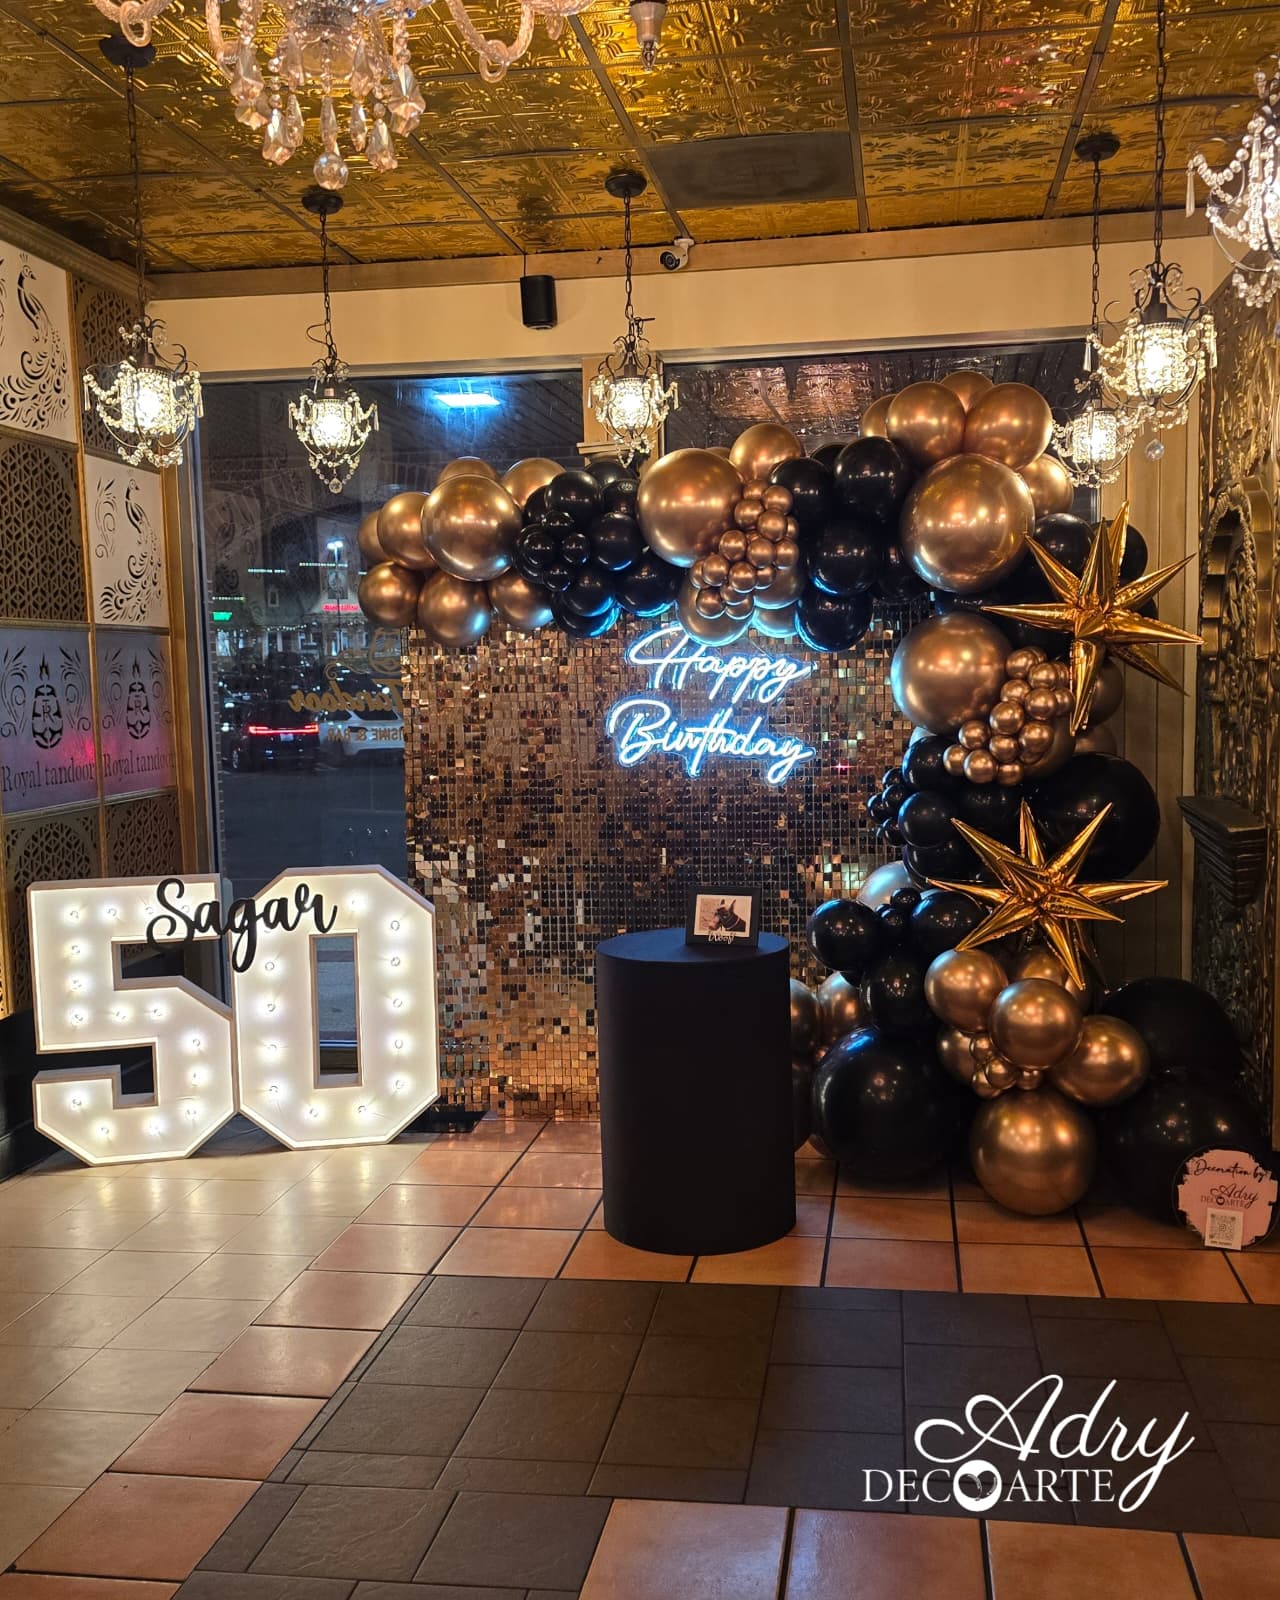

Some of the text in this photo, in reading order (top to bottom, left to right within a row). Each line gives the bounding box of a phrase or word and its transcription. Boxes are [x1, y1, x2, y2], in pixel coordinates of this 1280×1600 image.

[628, 625, 814, 703] Happy
[103, 750, 135, 782] Royal
[608, 698, 817, 784] Birthday
[1, 758, 96, 796] Royal tandoor
[146, 878, 338, 973] Sagar
[27, 865, 439, 1166] 50
[1193, 1158, 1267, 1183] Decoration by
[1210, 1182, 1259, 1209] Adry
